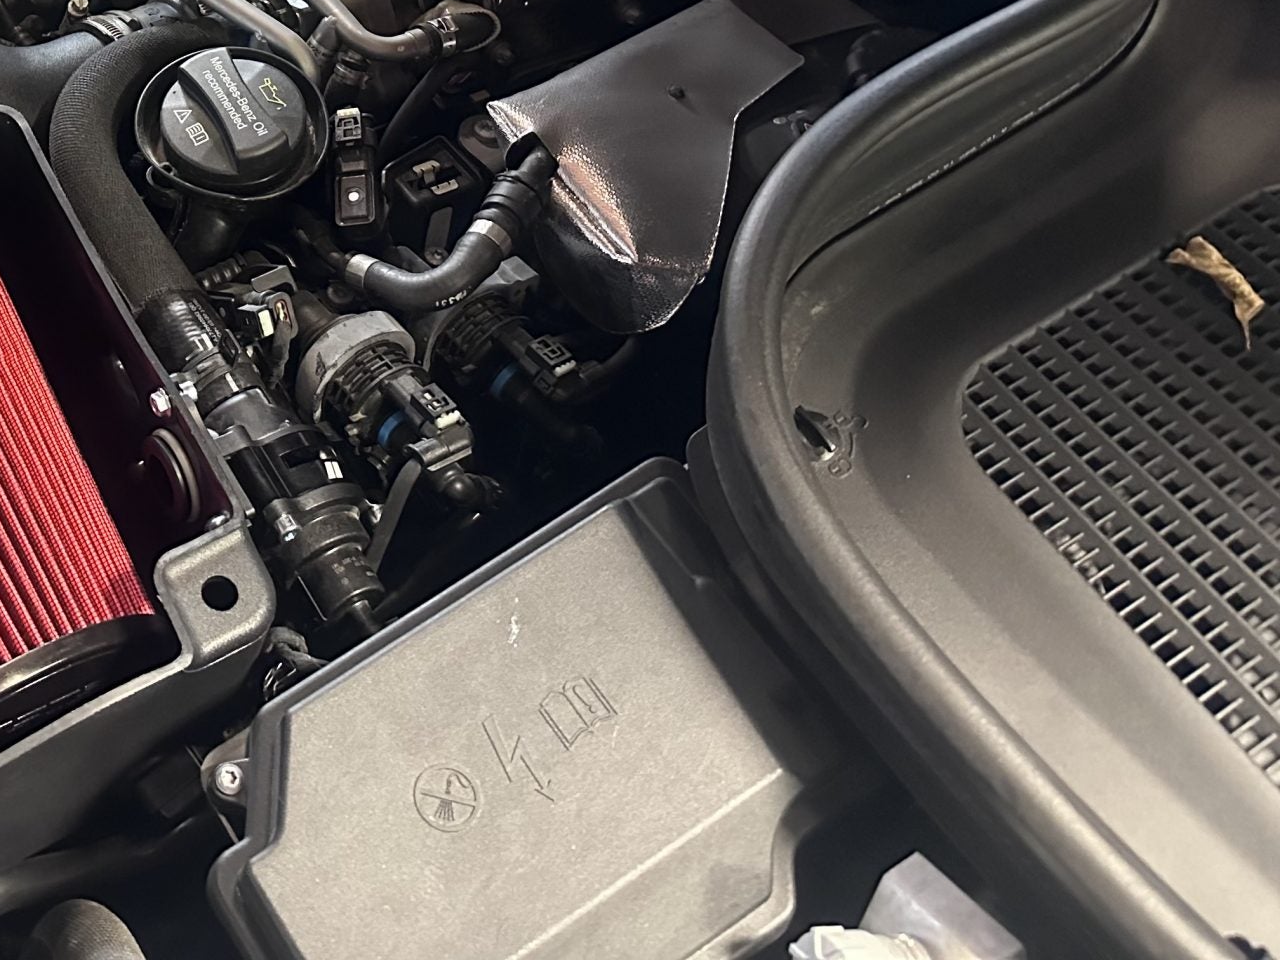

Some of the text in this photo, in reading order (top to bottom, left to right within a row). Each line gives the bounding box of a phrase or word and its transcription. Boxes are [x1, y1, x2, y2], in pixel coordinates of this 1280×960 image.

[202, 70, 248, 130] recommended
[210, 56, 269, 137] Mercedes-Benz Oil
